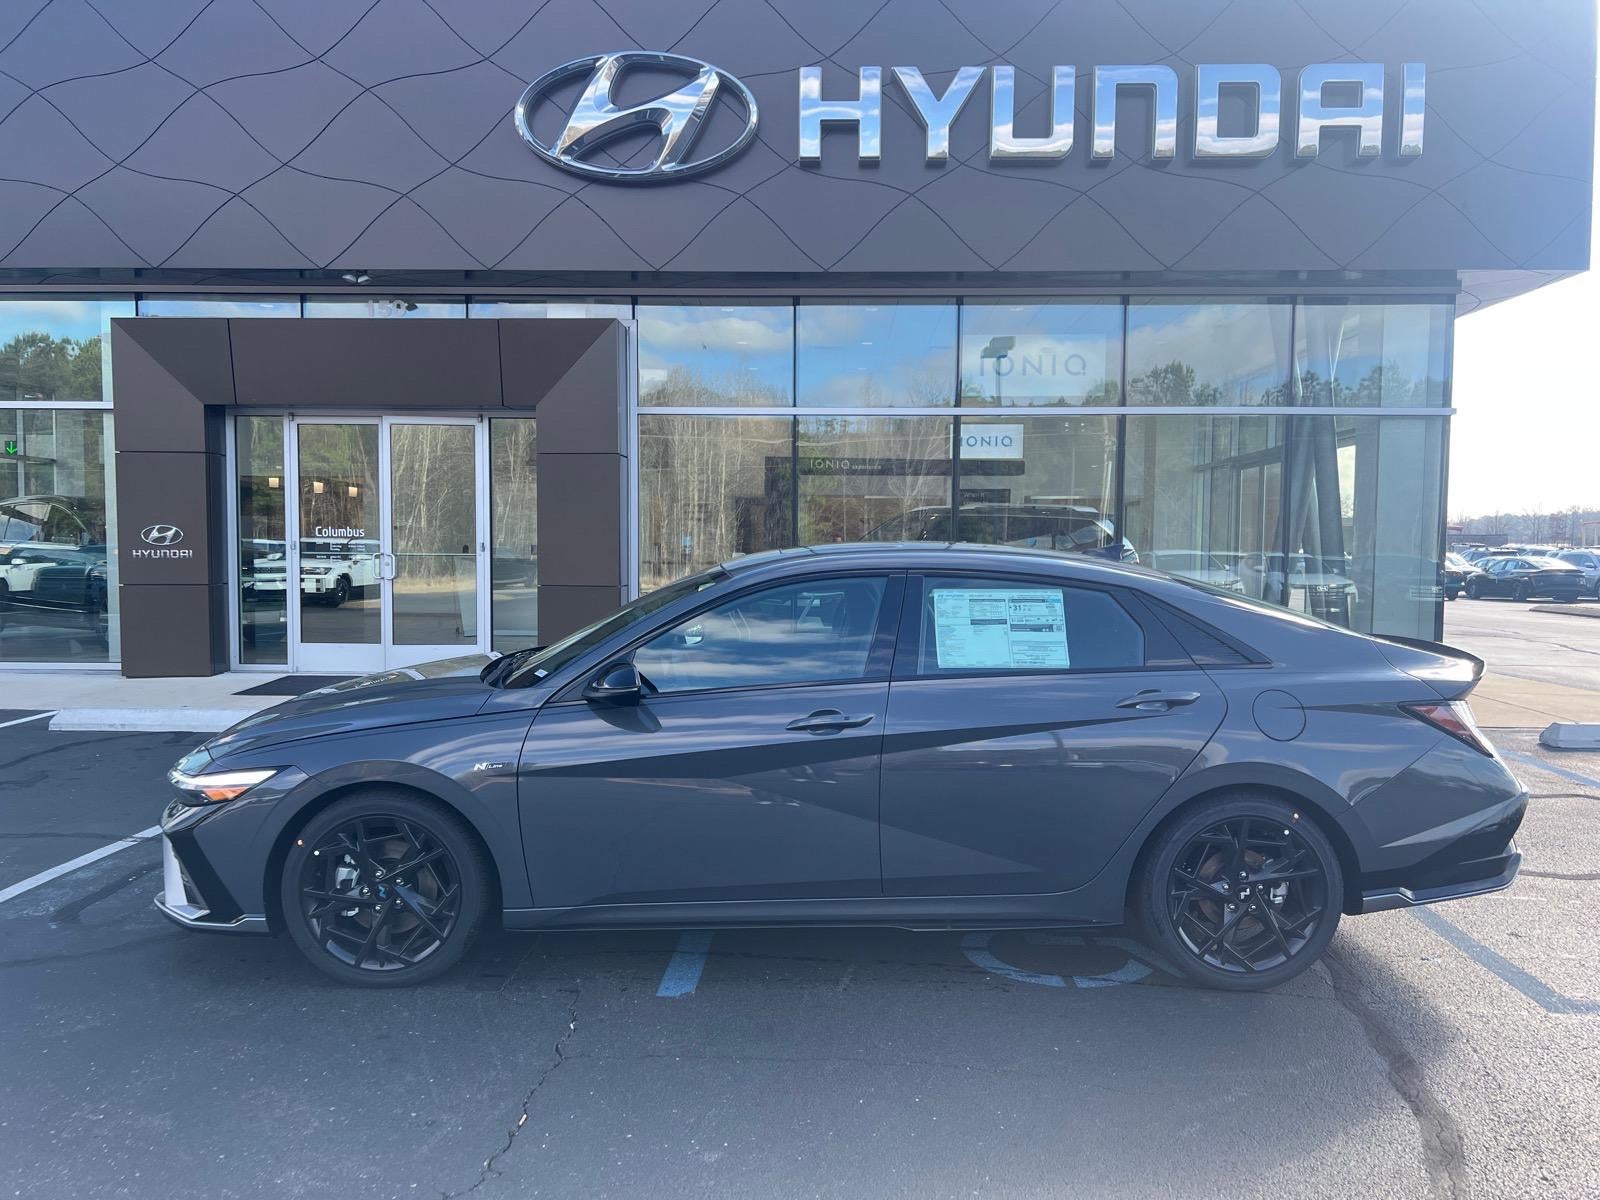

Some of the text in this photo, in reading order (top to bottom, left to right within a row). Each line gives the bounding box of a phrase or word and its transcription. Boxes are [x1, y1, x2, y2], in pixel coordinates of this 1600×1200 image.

[798, 62, 1427, 162] HYUNDAI
[979, 353, 1087, 376] IONIQ
[810, 459, 850, 470] IONIQ
[315, 526, 365, 538] Columbus
[132, 549, 193, 559] HYUNDAI
